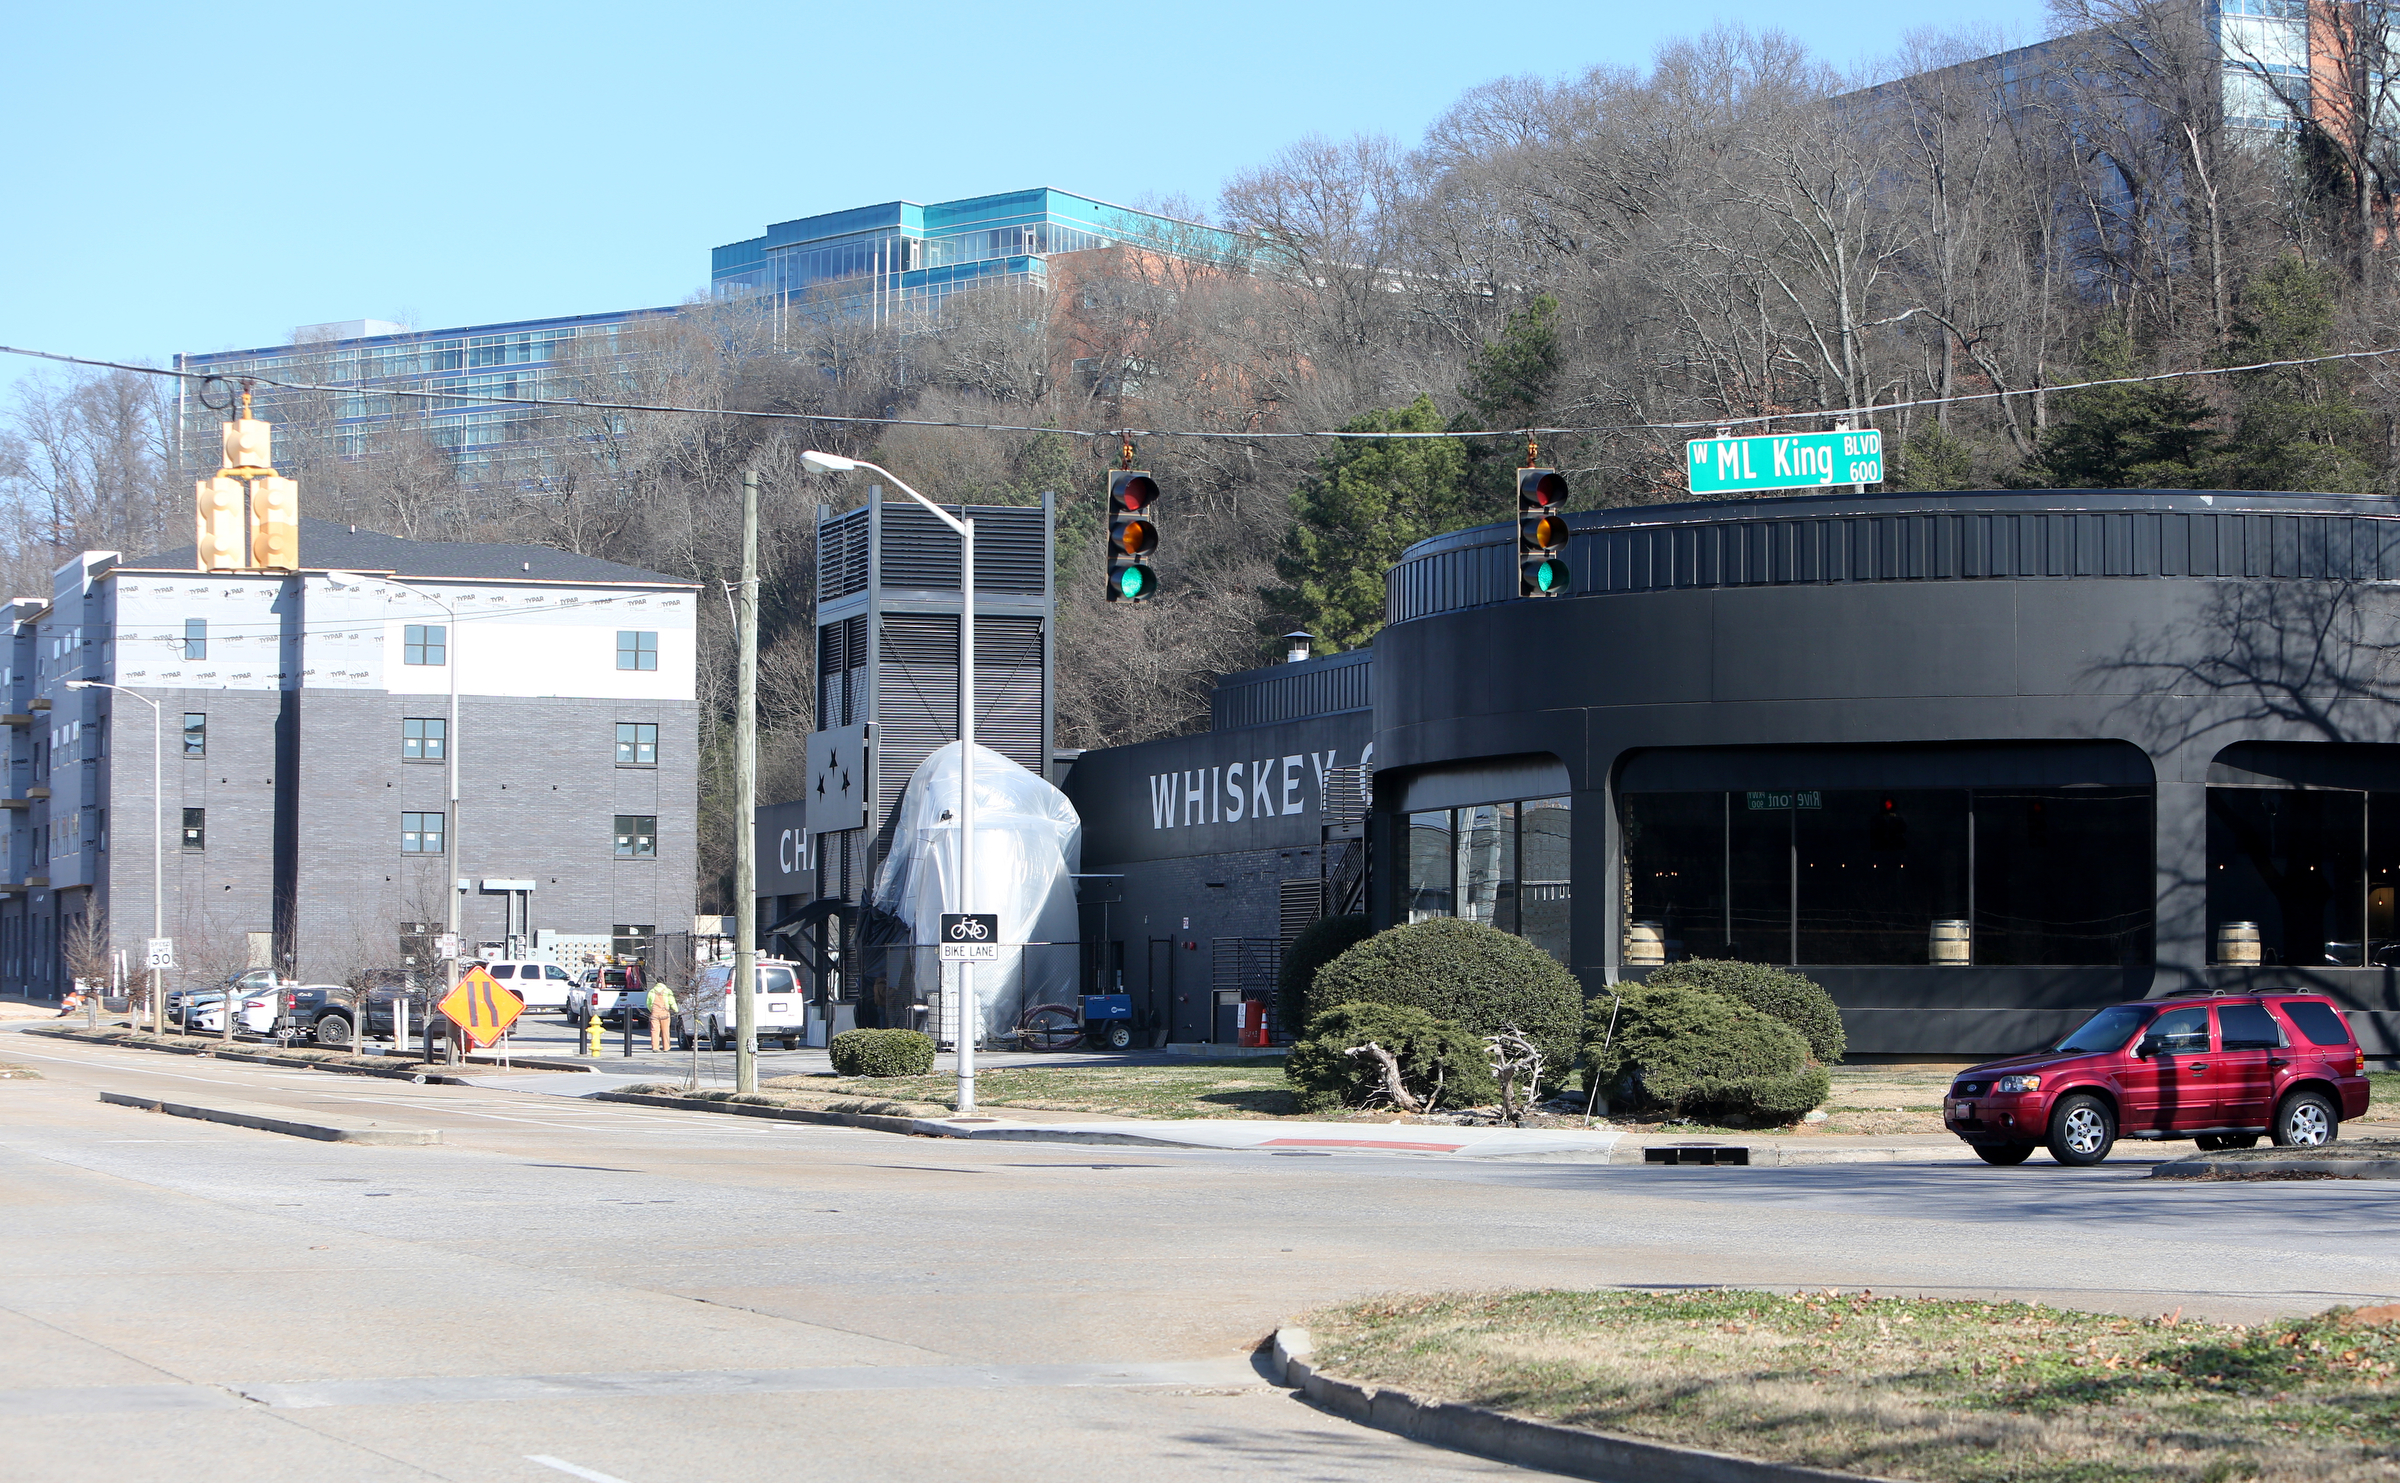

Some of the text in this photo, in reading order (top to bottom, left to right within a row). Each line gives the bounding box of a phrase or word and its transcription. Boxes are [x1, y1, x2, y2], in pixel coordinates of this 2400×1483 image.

[1693, 434, 1879, 484] W ML King BLVD
[1849, 461, 1878, 482] 600
[118, 586, 139, 594] TYPAR
[154, 586, 174, 595] TYPAR
[188, 587, 209, 595] TYPAR
[456, 594, 476, 602] TYPAR
[524, 596, 545, 604] TYPAR
[627, 599, 647, 607] TYPAR
[661, 600, 681, 608] TYPAR
[323, 633, 343, 641] TYPAR
[126, 670, 146, 679] TYPAR
[161, 671, 181, 679] TYPAR
[196, 672, 216, 680] TYPAR
[231, 672, 252, 680] TYPAR
[349, 671, 369, 680] TYPAR
[1150, 750, 1336, 829] WHISKEY
[945, 946, 994, 956] BIKE LANE
[152, 954, 170, 965] 30
